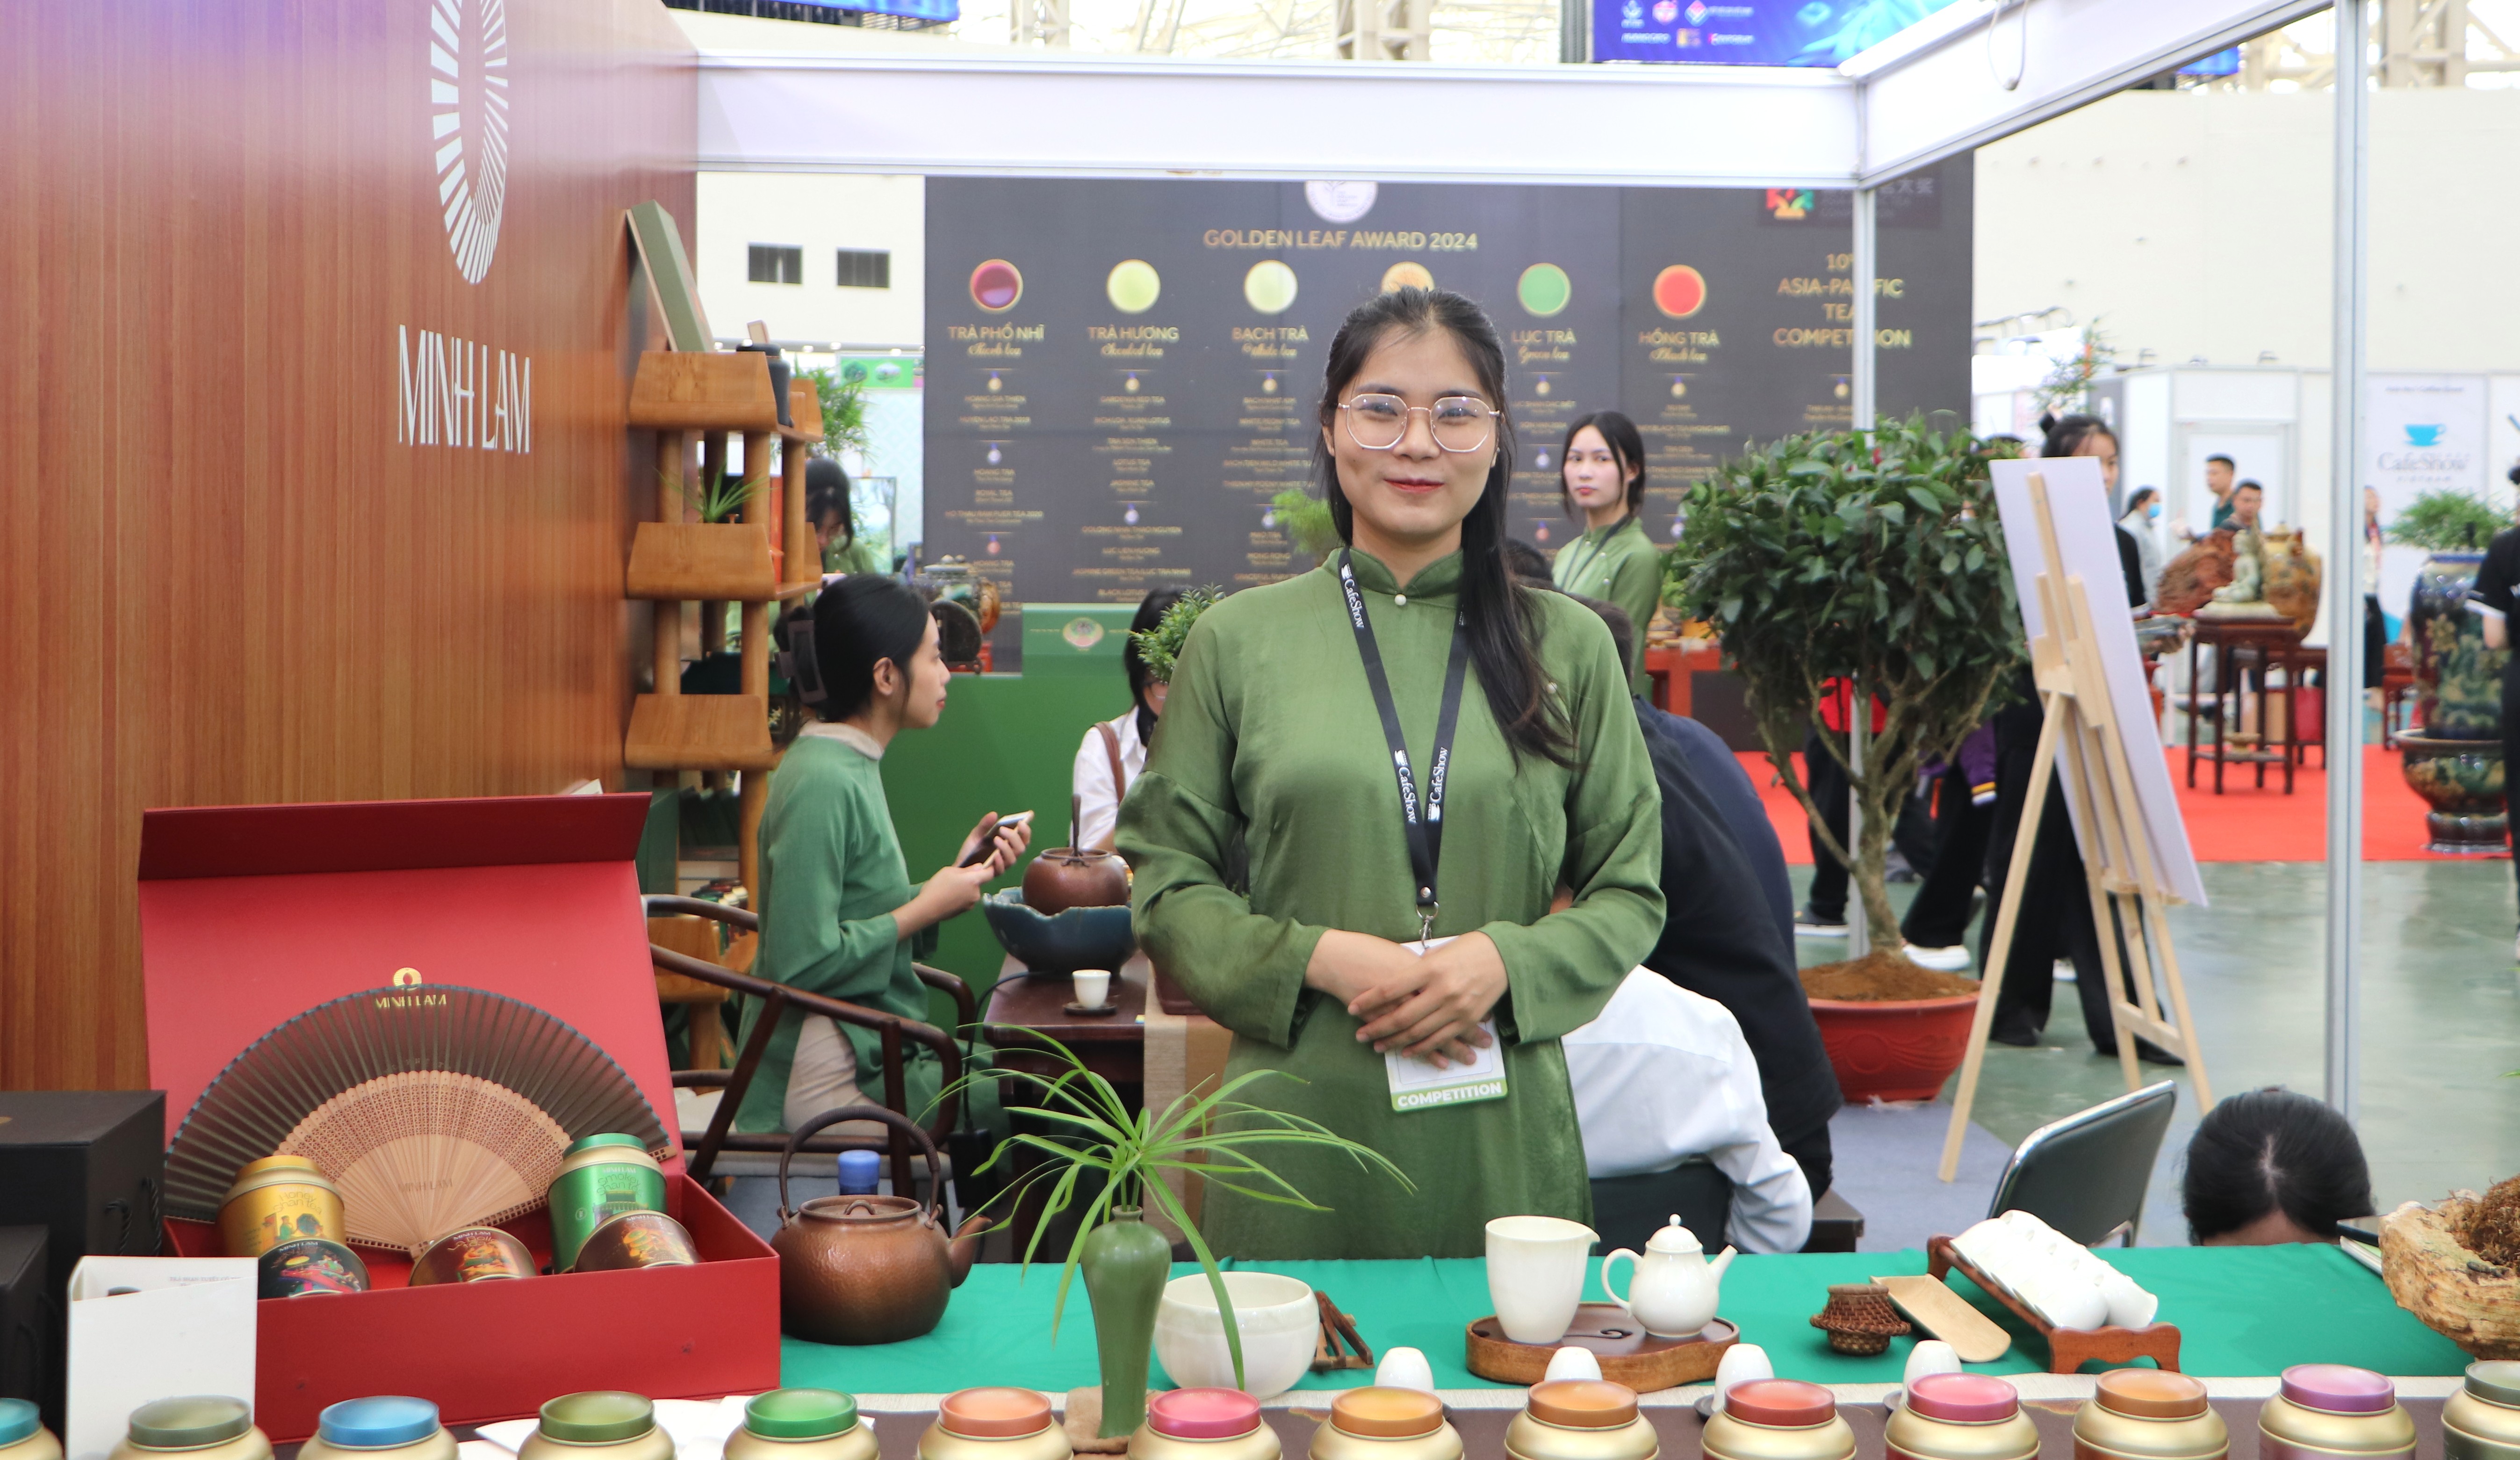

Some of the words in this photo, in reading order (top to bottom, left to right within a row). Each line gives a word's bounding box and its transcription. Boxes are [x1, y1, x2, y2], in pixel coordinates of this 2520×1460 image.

[1204, 230, 1294, 248] GOLDEN
[1296, 231, 1347, 249] LEAF
[1351, 231, 1426, 250] AWARD
[1430, 232, 1478, 251] 2024
[1778, 278, 1905, 298] ASIA-PAFIC
[948, 324, 978, 339] TRÀ
[1087, 324, 1118, 340] TRÀ
[1278, 325, 1309, 340] TRÀ
[1545, 328, 1577, 344] TRÀ
[1690, 329, 1720, 345] TRÀ
[1773, 327, 1913, 348] COMPETION
[399, 324, 475, 447] MINH
[482, 344, 530, 454] LAM
[1344, 578, 1365, 629] CafeShow
[1429, 746, 1448, 802] CafeShow
[1397, 766, 1418, 824] CafeShow
[375, 995, 411, 1009] MINH
[416, 994, 446, 1006] LAM
[1397, 1081, 1502, 1107] COMPETITION
[430, 1178, 453, 1190] LAM
[279, 1192, 317, 1202] Honey
[453, 1232, 474, 1240] MINH
[279, 1243, 300, 1252] MINH
